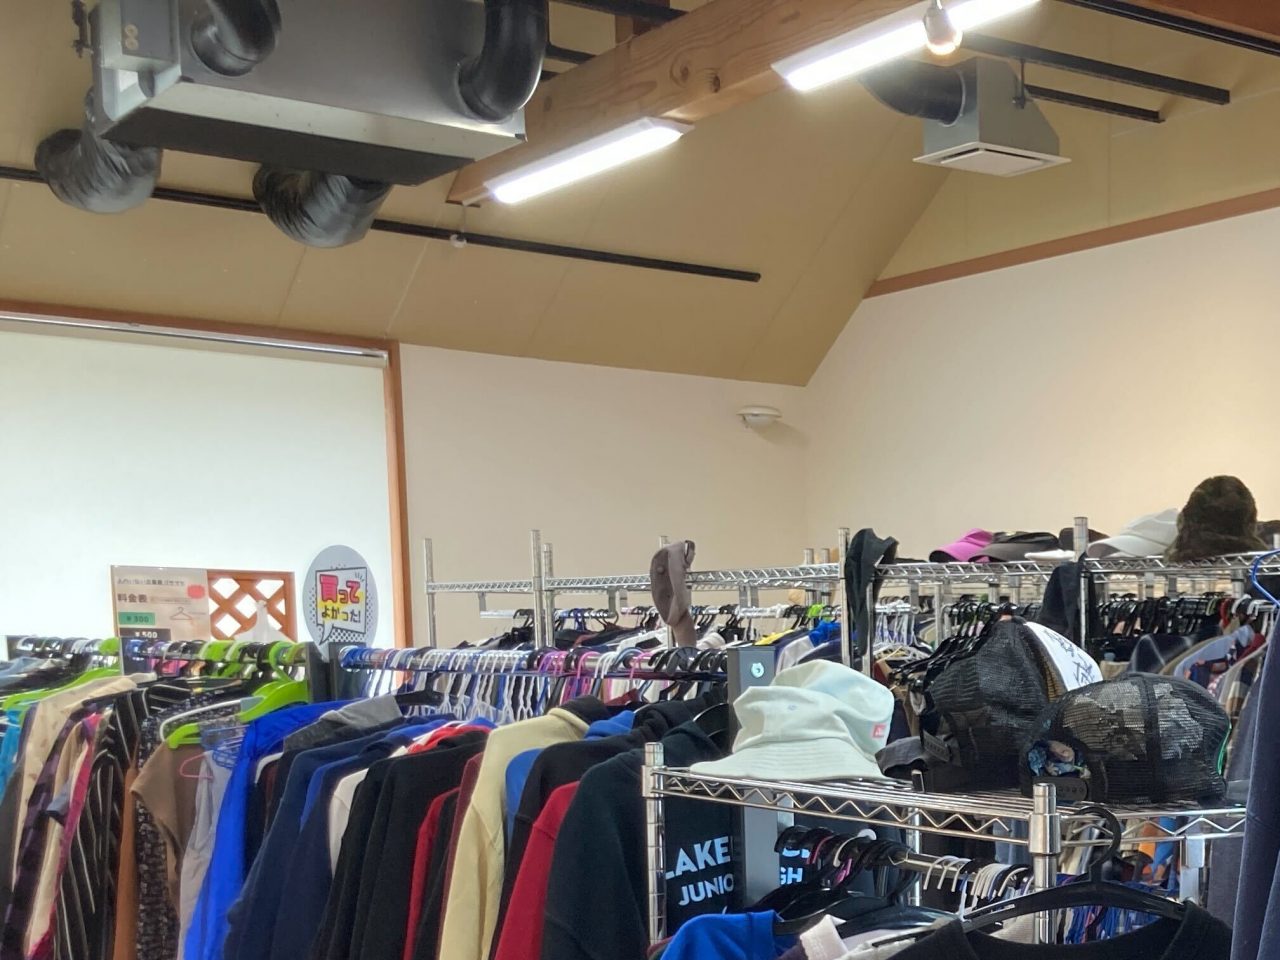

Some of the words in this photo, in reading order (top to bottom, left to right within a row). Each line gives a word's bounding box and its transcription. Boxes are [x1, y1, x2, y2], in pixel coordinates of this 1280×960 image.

[319, 573, 361, 604] 買って
[678, 873, 734, 906] JUNIO
